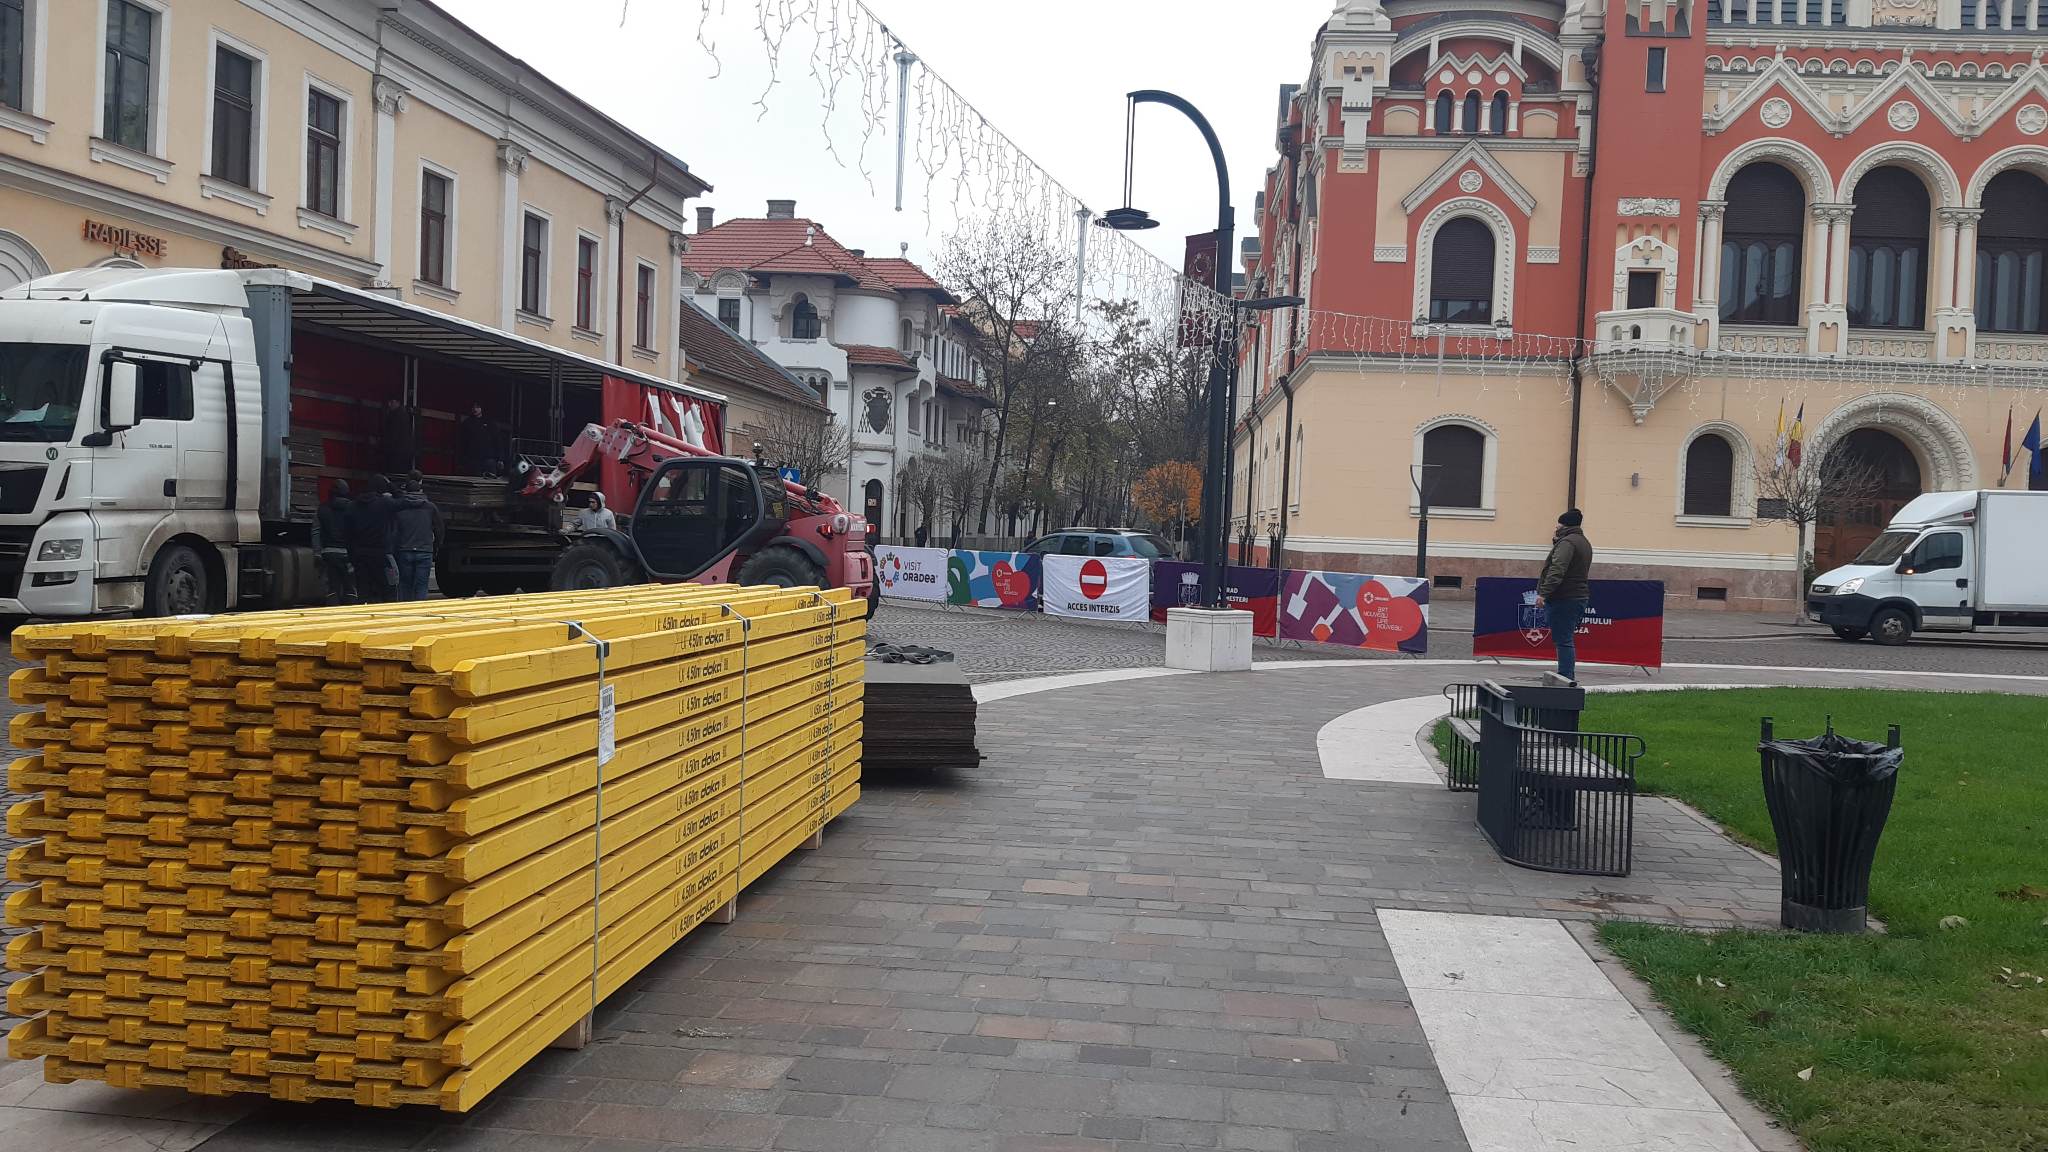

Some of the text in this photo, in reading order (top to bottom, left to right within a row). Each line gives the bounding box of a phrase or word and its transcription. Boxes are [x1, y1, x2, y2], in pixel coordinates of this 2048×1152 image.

[85, 219, 167, 256] RADIESSE
[1068, 602, 1120, 614] ACCES INTERZIS
[704, 629, 723, 644] doka
[702, 659, 721, 675] doka
[703, 689, 721, 705] doka
[703, 719, 721, 736] doka
[701, 748, 720, 766] doka
[700, 780, 719, 798] doka
[699, 809, 718, 828] doka
[699, 839, 718, 859] doka
[698, 866, 716, 888] doka
[696, 894, 715, 918] doka
